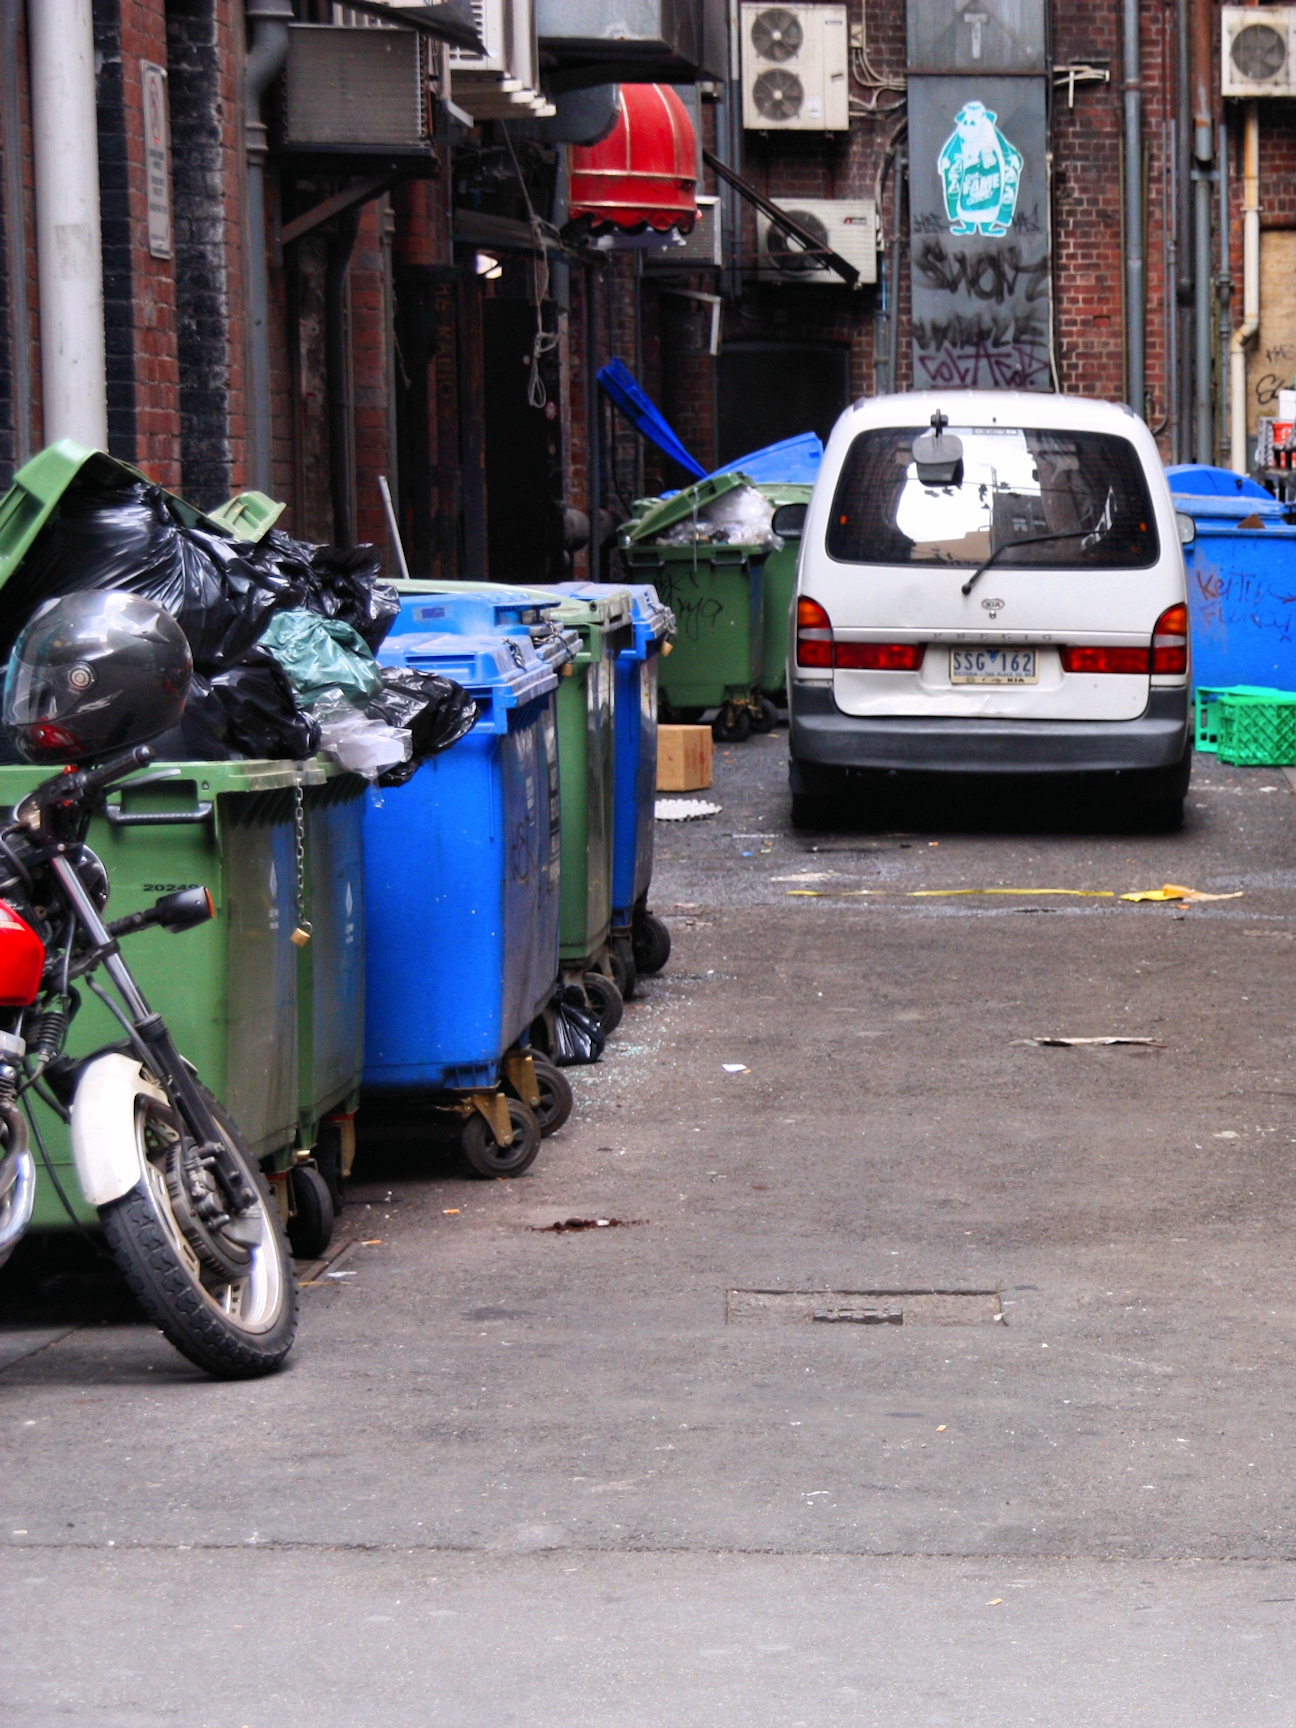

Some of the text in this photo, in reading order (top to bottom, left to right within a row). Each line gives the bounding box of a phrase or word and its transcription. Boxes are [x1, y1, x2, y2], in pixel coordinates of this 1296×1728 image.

[962, 173, 1000, 195] FAME
[954, 652, 1032, 672] SSG 162
